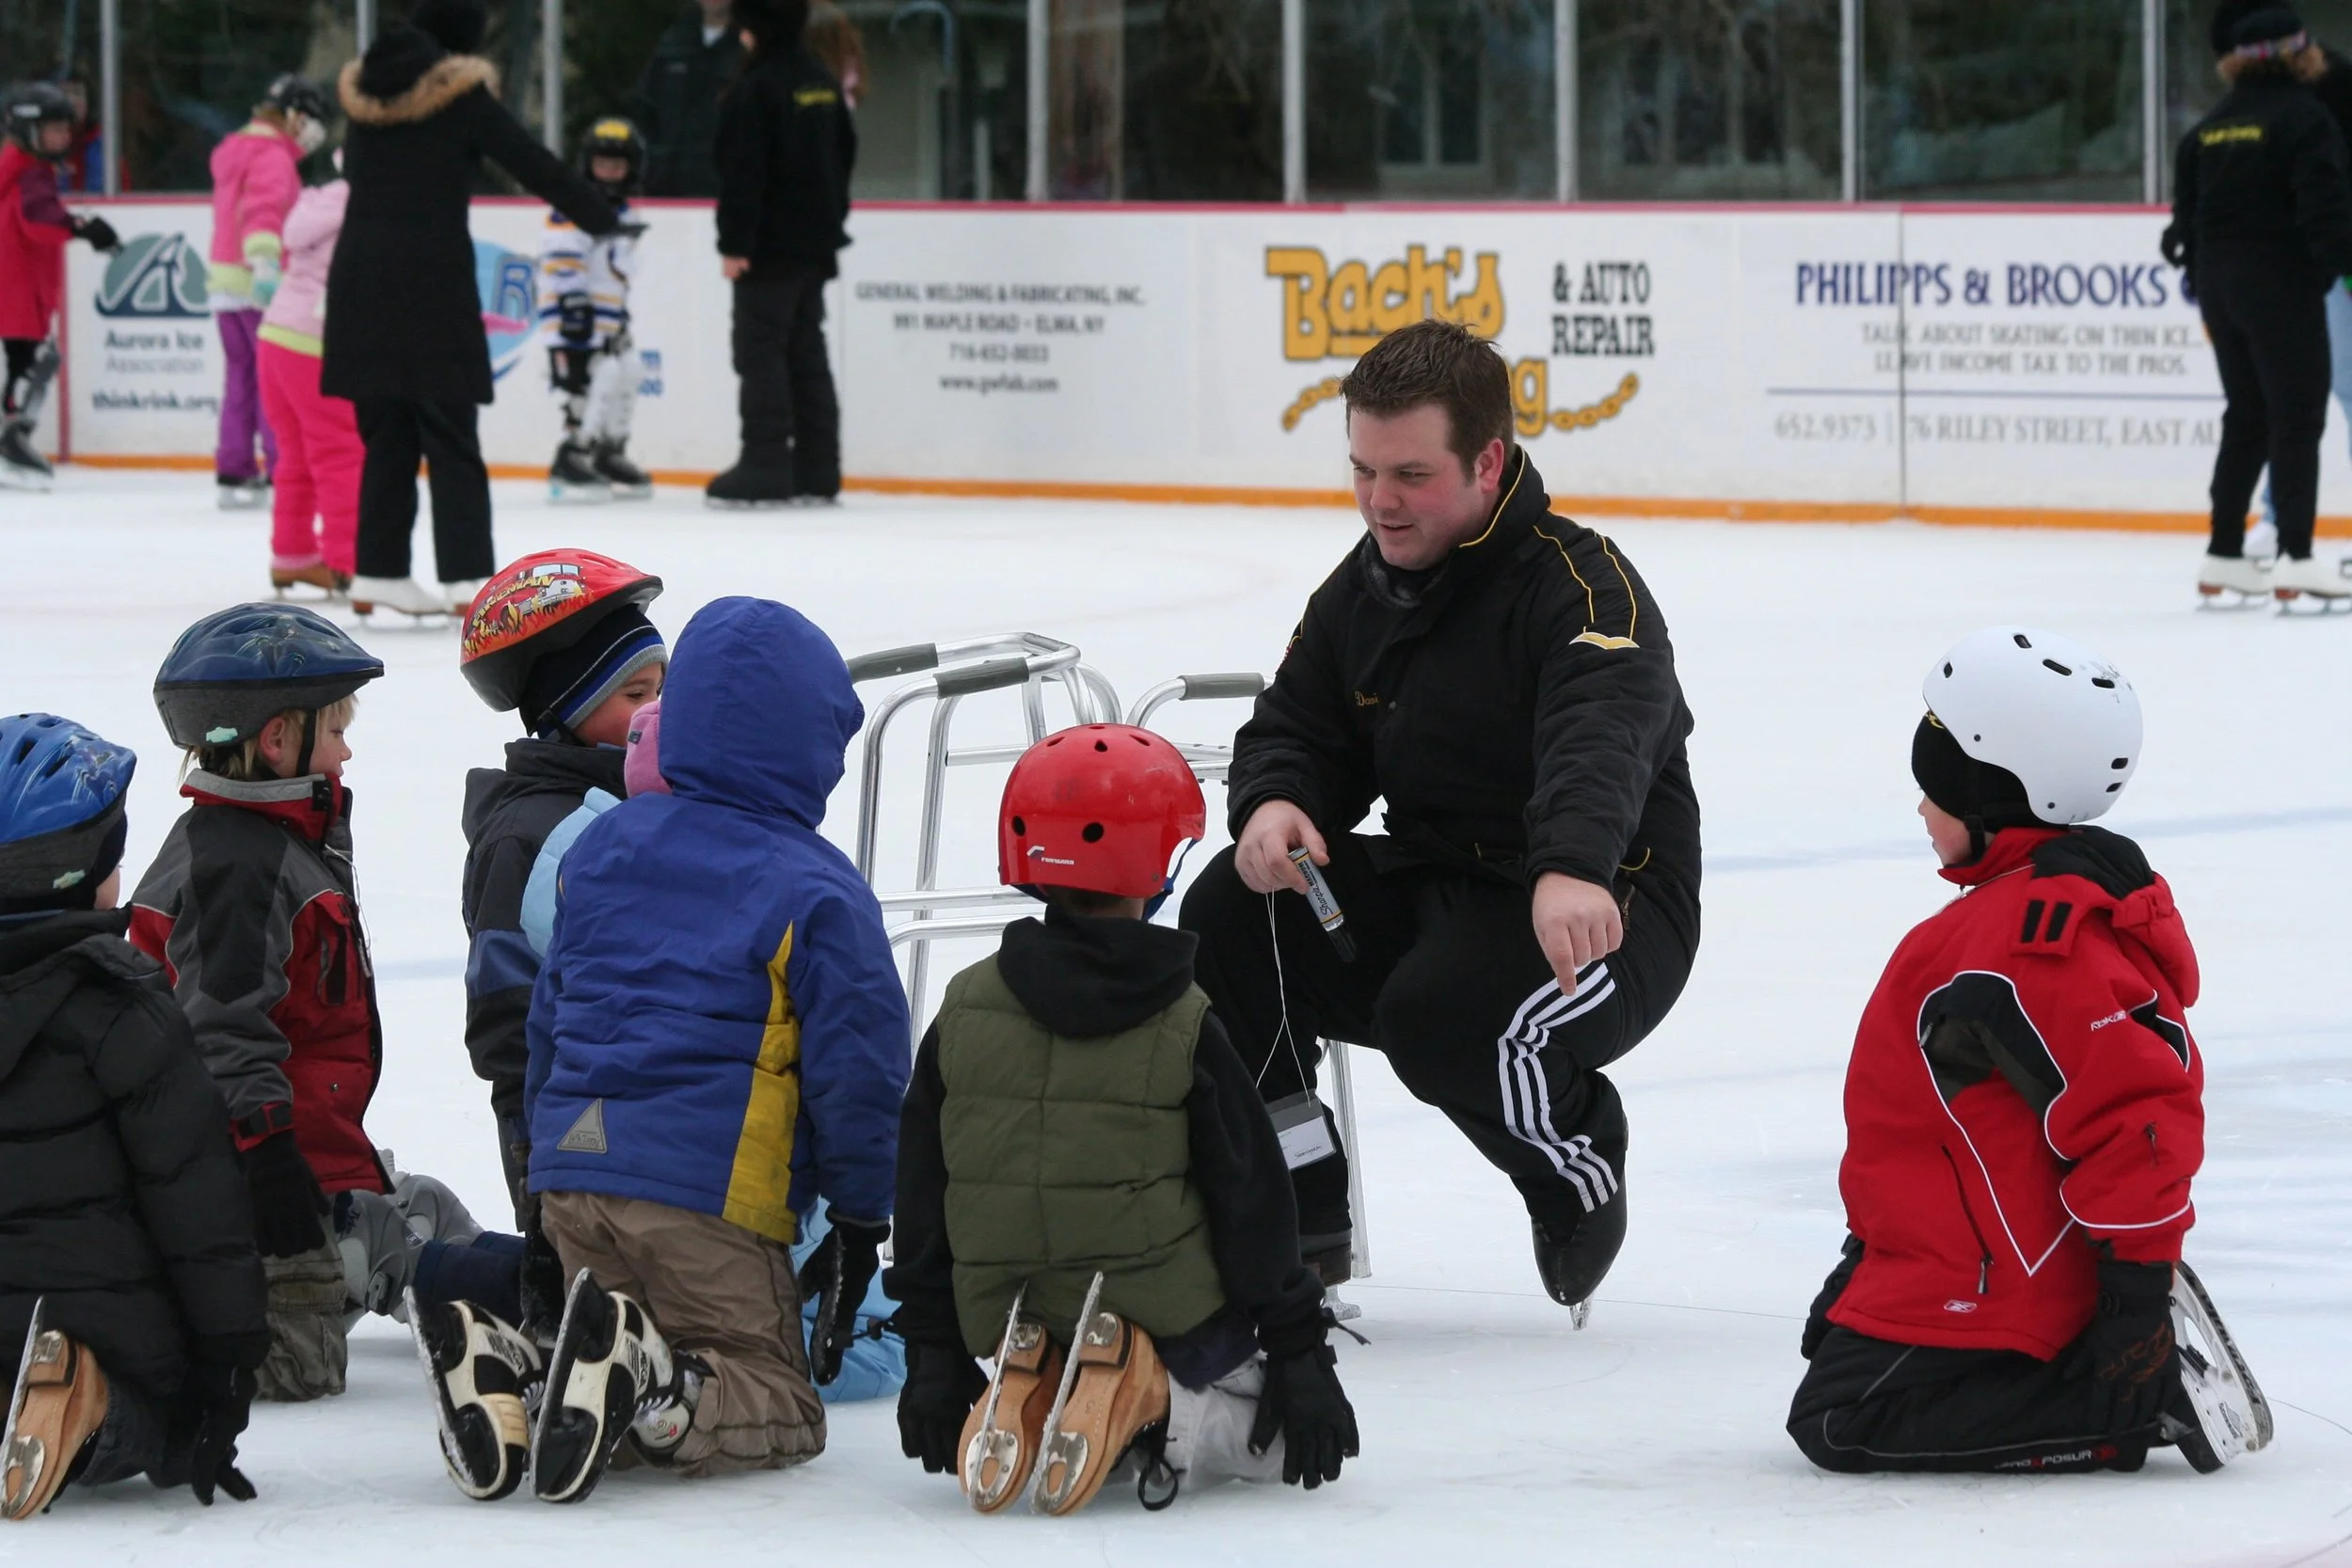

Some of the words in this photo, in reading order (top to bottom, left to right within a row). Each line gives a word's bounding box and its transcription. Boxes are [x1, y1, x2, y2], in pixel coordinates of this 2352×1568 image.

[856, 282, 920, 301] GENERAL
[926, 283, 993, 302] WELDING
[1552, 261, 1572, 303] &
[1579, 261, 1651, 304] AUTO
[1795, 261, 1952, 306] PHILIPPS
[1963, 267, 1992, 306] &
[2006, 262, 2168, 307] BROOKS
[1265, 244, 1505, 360] Bach's
[924, 312, 972, 332] MAPLE
[977, 314, 1020, 332] ROAD
[104, 329, 170, 349] Aurora
[176, 329, 204, 349] Ice
[1551, 314, 1654, 356] REPAIR
[1920, 324, 1983, 346] ABOUT
[1989, 325, 2068, 347] SKATING
[2074, 325, 2103, 346] ON
[2110, 325, 2156, 347] THIN
[105, 356, 204, 373] Association
[1939, 353, 2011, 373] INCOME
[2022, 353, 2058, 373] TAX
[2066, 354, 2091, 373] TO
[2098, 354, 2129, 374] THE
[91, 390, 218, 415] thinkrink.org
[1936, 414, 2011, 443] RILEY
[2014, 415, 2113, 448] STREET,
[2122, 417, 2187, 445] EAST
